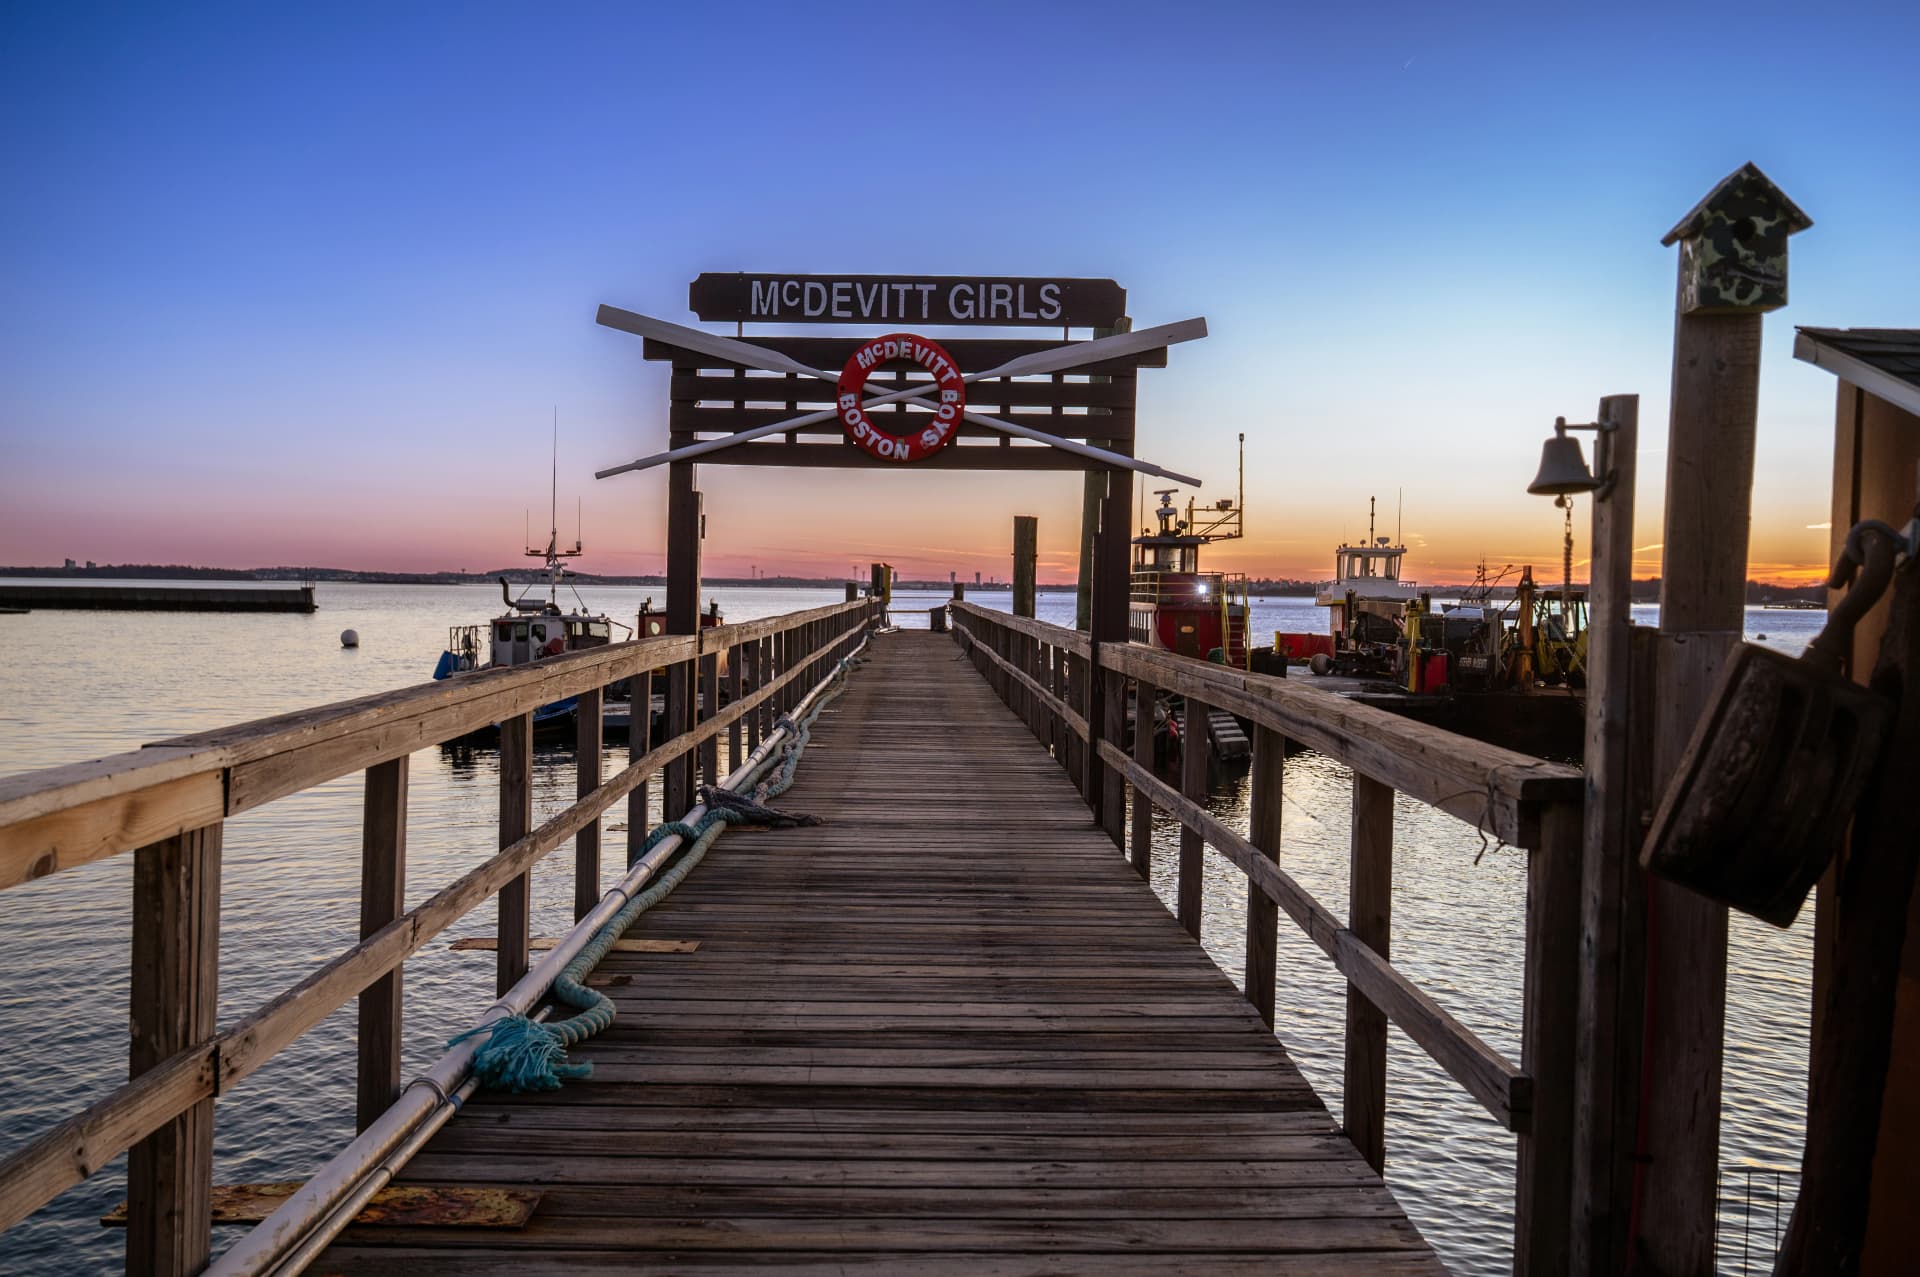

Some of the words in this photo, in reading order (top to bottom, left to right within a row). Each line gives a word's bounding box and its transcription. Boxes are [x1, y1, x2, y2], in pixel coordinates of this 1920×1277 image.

[949, 283, 1062, 320] GIRLS
[839, 393, 910, 461] BOSTON
[921, 389, 958, 446] BOYS
